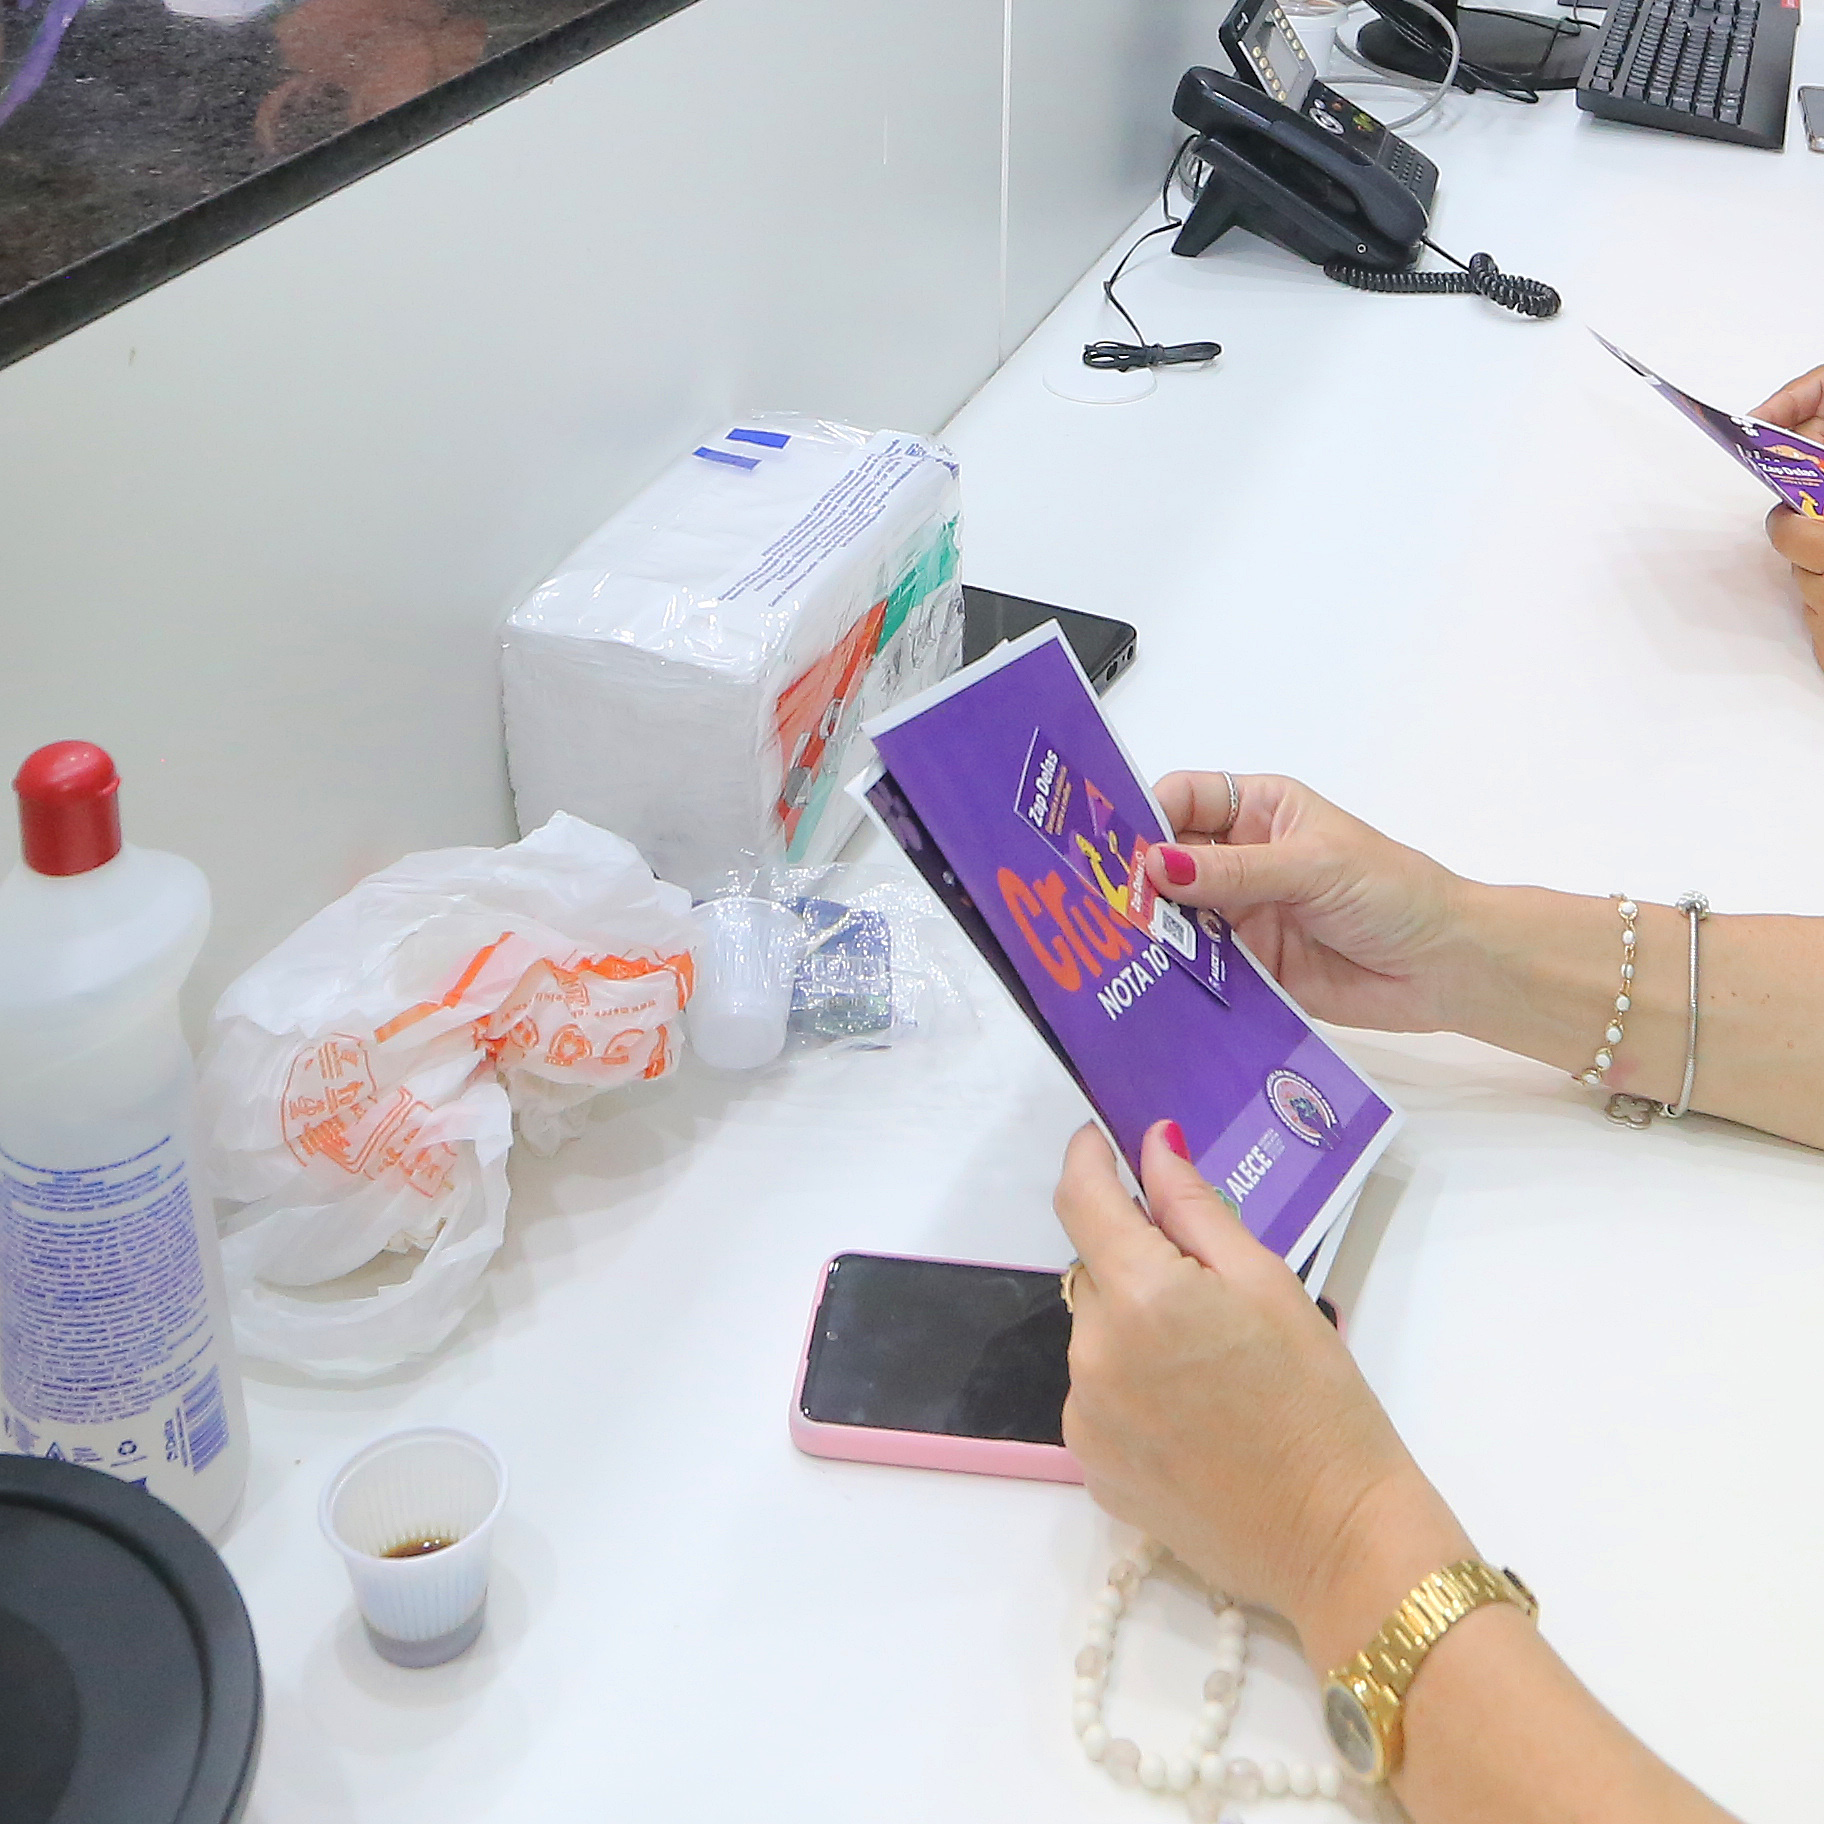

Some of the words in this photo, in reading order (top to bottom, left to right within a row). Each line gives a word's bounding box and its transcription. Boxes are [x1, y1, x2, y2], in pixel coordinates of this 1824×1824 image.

[1758, 462, 1783, 477] Zap
[1783, 465, 1819, 478] Delas
[1034, 749, 1060, 796] Delas
[1027, 792, 1050, 828] Zap
[996, 866, 1134, 993] Cru
[1096, 961, 1156, 1021] NOTA
[1141, 942, 1171, 978] 10
[1226, 1145, 1275, 1204] ALECE
